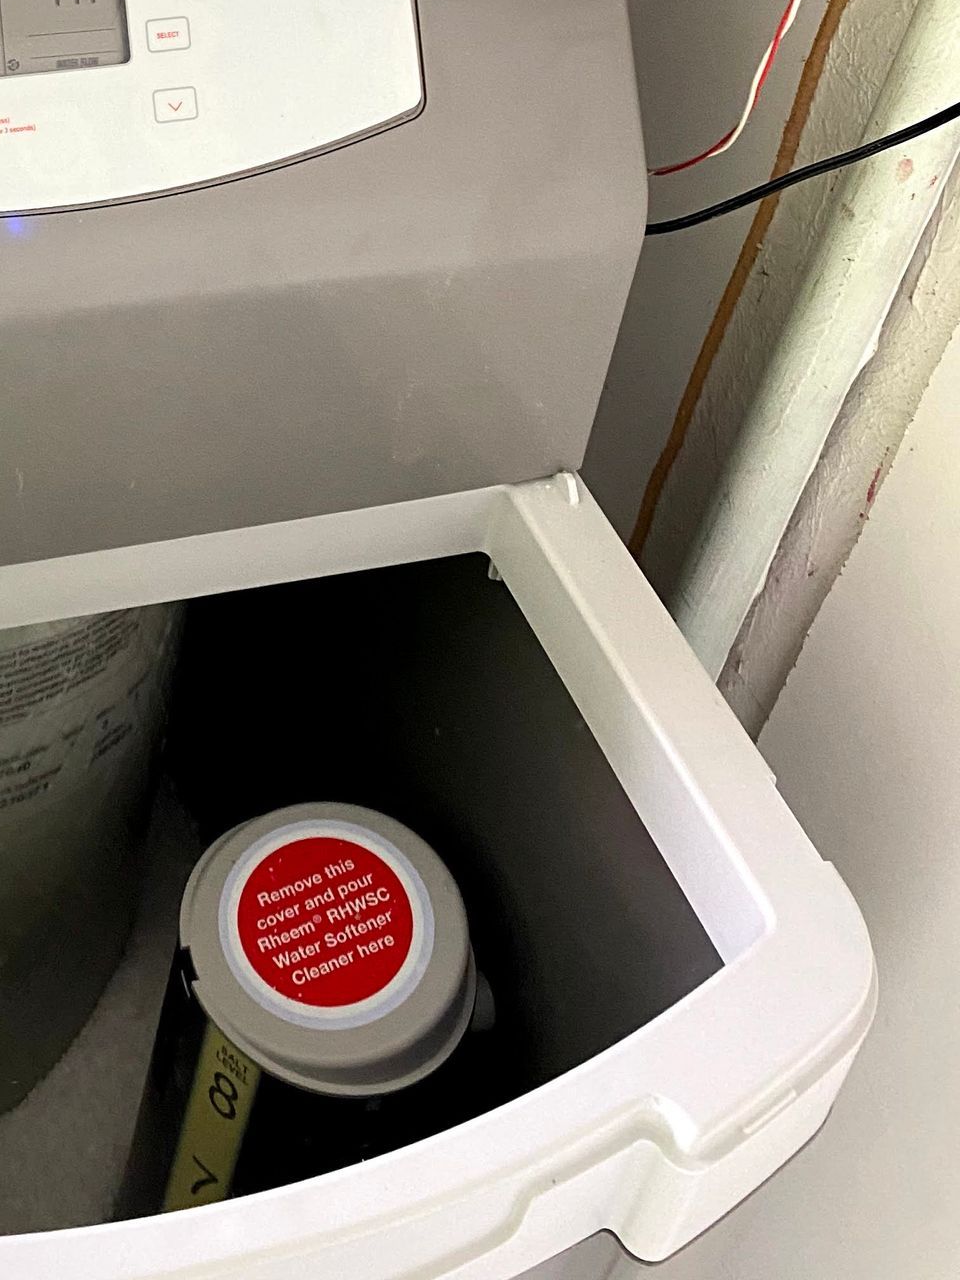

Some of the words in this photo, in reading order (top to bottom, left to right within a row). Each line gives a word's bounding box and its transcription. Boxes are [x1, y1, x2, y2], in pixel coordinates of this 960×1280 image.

[156, 31, 178, 39] SELECT
[9, 124, 36, 132] seconds)
[257, 874, 322, 906] Remove
[324, 859, 354, 878] this
[257, 904, 299, 929] cover
[304, 887, 334, 910] and
[337, 873, 372, 899] pour
[326, 888, 389, 922] RHWSC
[272, 942, 320, 968] Water
[324, 912, 390, 947] Softener
[292, 952, 353, 984] Cleaner
[356, 935, 394, 957] here
[208, 1071, 238, 1120] 8
